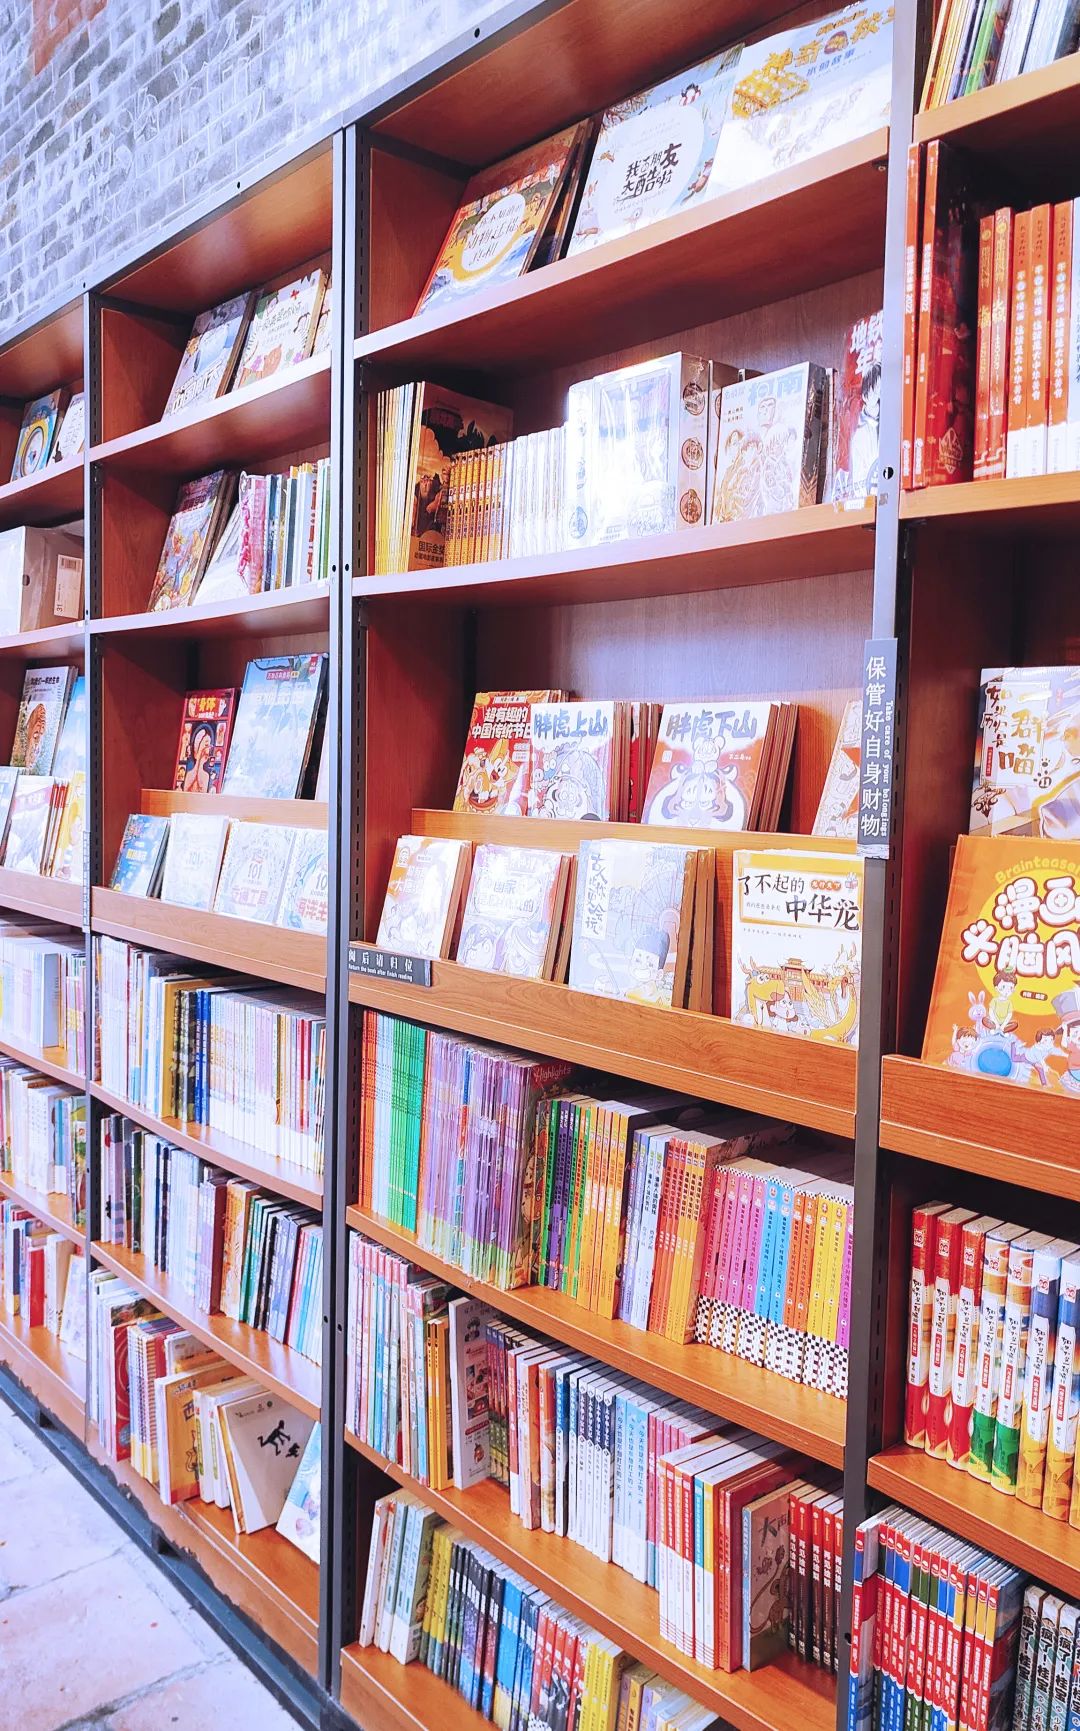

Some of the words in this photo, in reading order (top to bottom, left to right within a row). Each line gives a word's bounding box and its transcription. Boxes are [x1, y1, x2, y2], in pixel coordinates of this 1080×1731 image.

[484, 706, 528, 723] 超有趣的
[885, 700, 894, 722] Take
[471, 722, 531, 740] 中国传统节日
[533, 709, 608, 740] 胖虎上山
[665, 709, 758, 742] 胖虎下山
[884, 725, 892, 746] care
[860, 656, 886, 837] 保管好自身财物
[883, 749, 891, 760] of
[882, 763, 890, 784] your
[880, 788, 890, 837] belongings
[738, 873, 805, 896] 了不起的
[993, 876, 1080, 933] 漫画
[398, 973, 413, 982] reading
